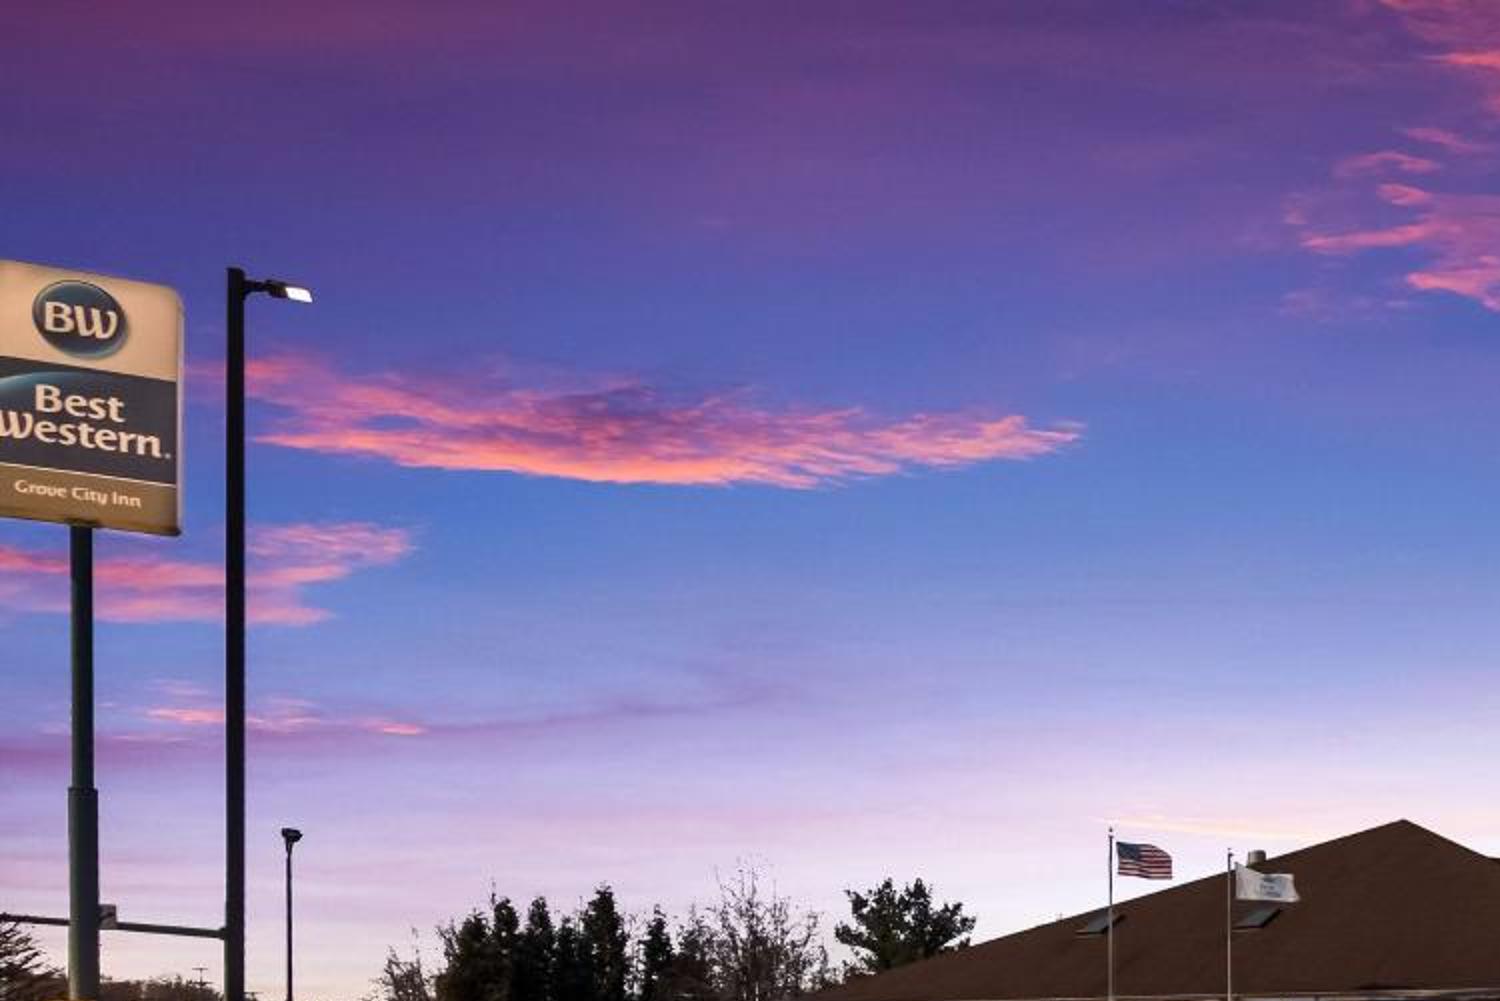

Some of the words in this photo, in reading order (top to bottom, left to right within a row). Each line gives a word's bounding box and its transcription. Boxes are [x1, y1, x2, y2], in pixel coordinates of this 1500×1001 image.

[44, 301, 118, 339] BW
[35, 383, 126, 422] Best
[0, 410, 162, 458] Western
[14, 479, 68, 498] Grove
[71, 487, 109, 505] City
[112, 491, 142, 507] Inn
